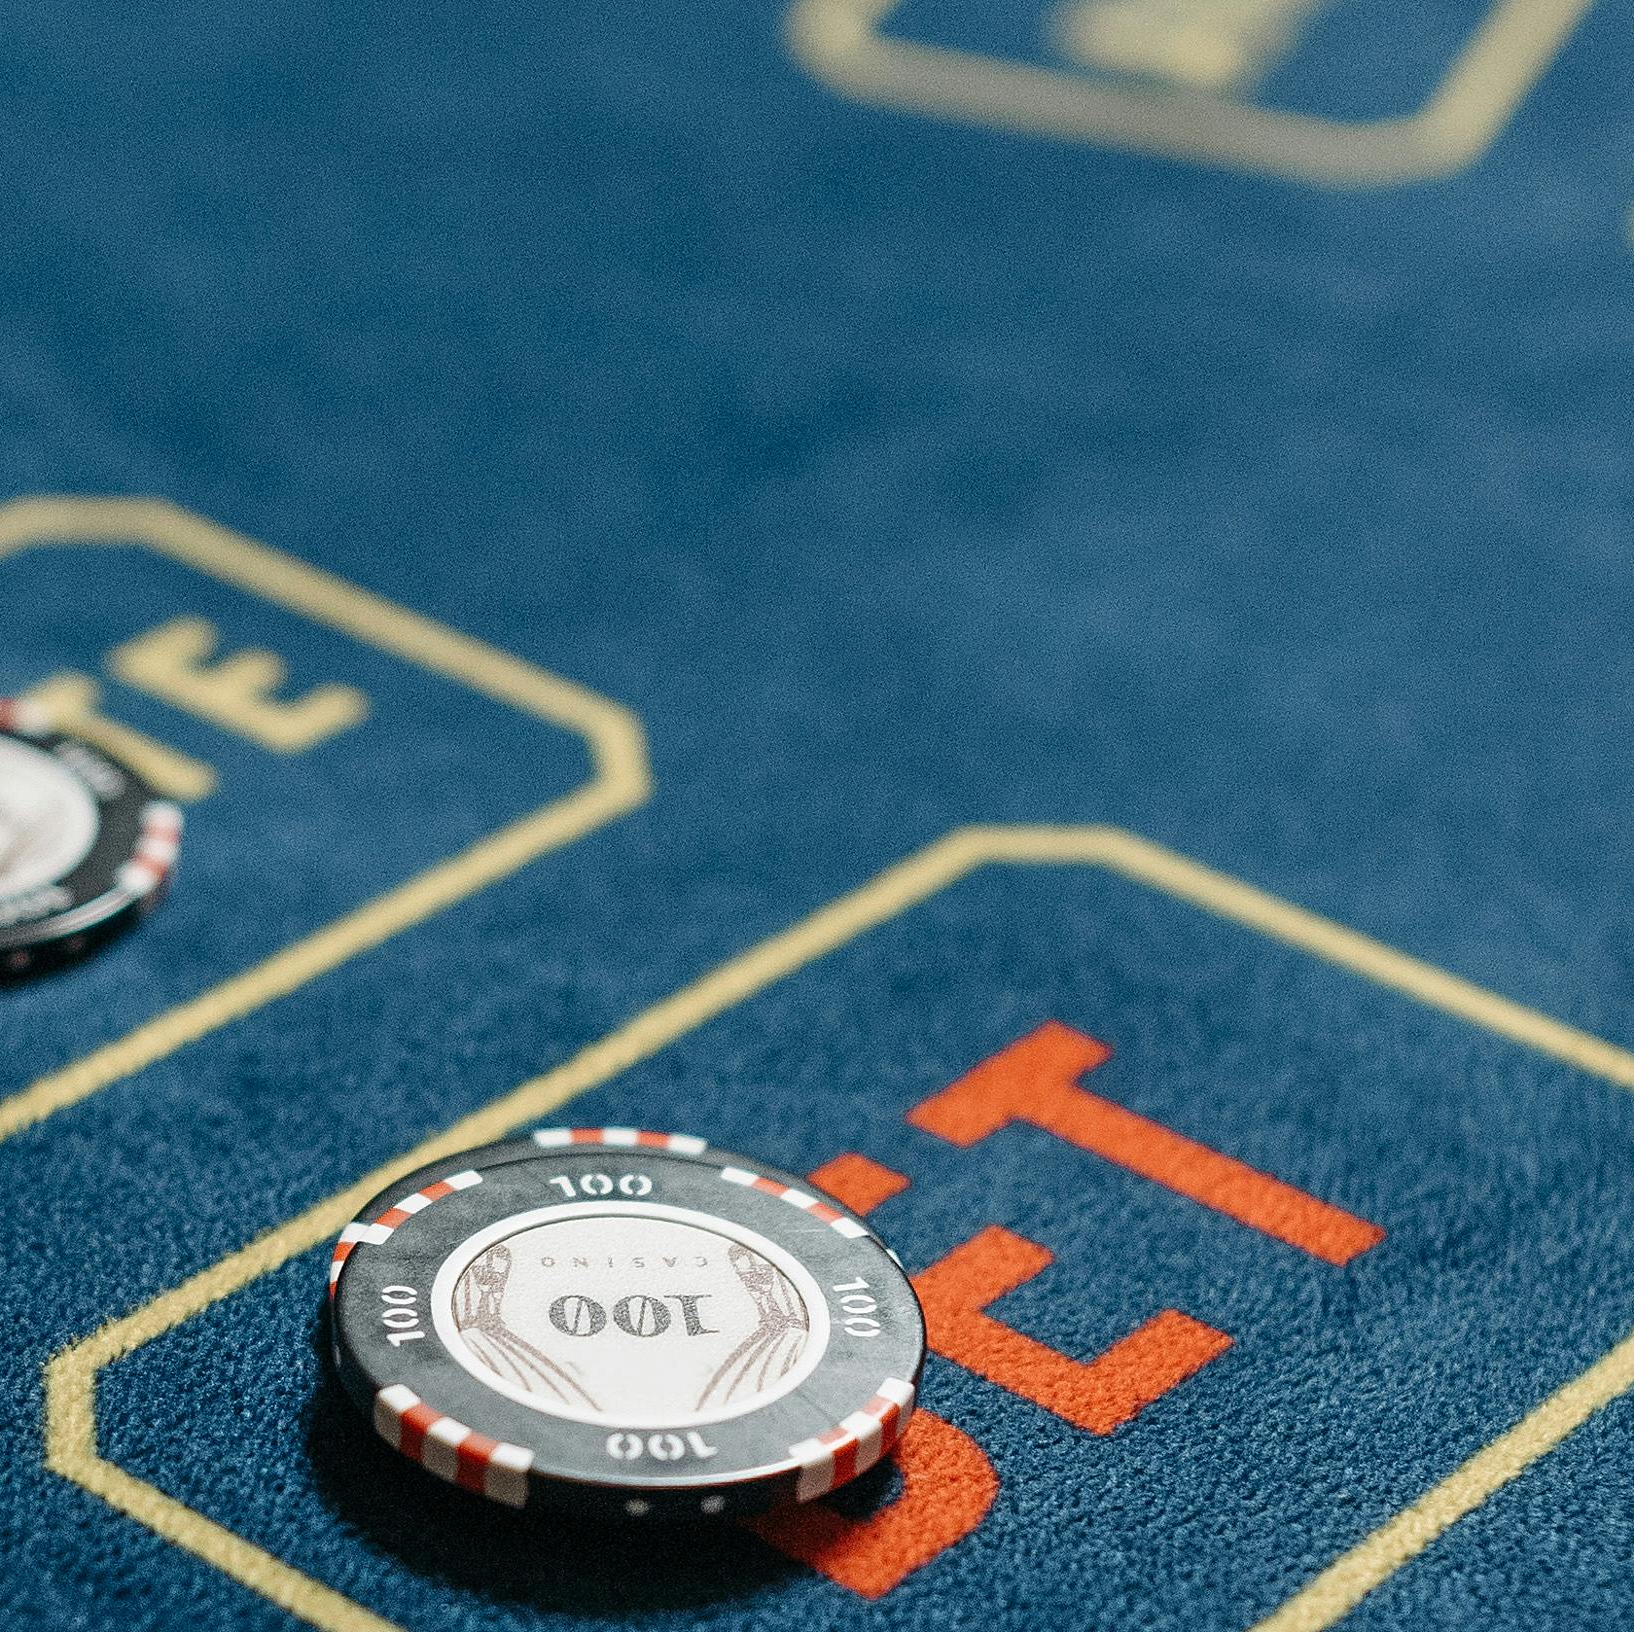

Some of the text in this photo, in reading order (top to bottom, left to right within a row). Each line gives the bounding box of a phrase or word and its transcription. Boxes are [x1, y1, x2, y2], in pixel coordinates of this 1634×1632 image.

[549, 1172, 653, 1199] 100
[540, 1254, 709, 1269] CASINO
[381, 1284, 424, 1346] 100
[548, 1293, 722, 1339] 100
[831, 1275, 882, 1339] 100
[605, 1431, 719, 1463] 100
